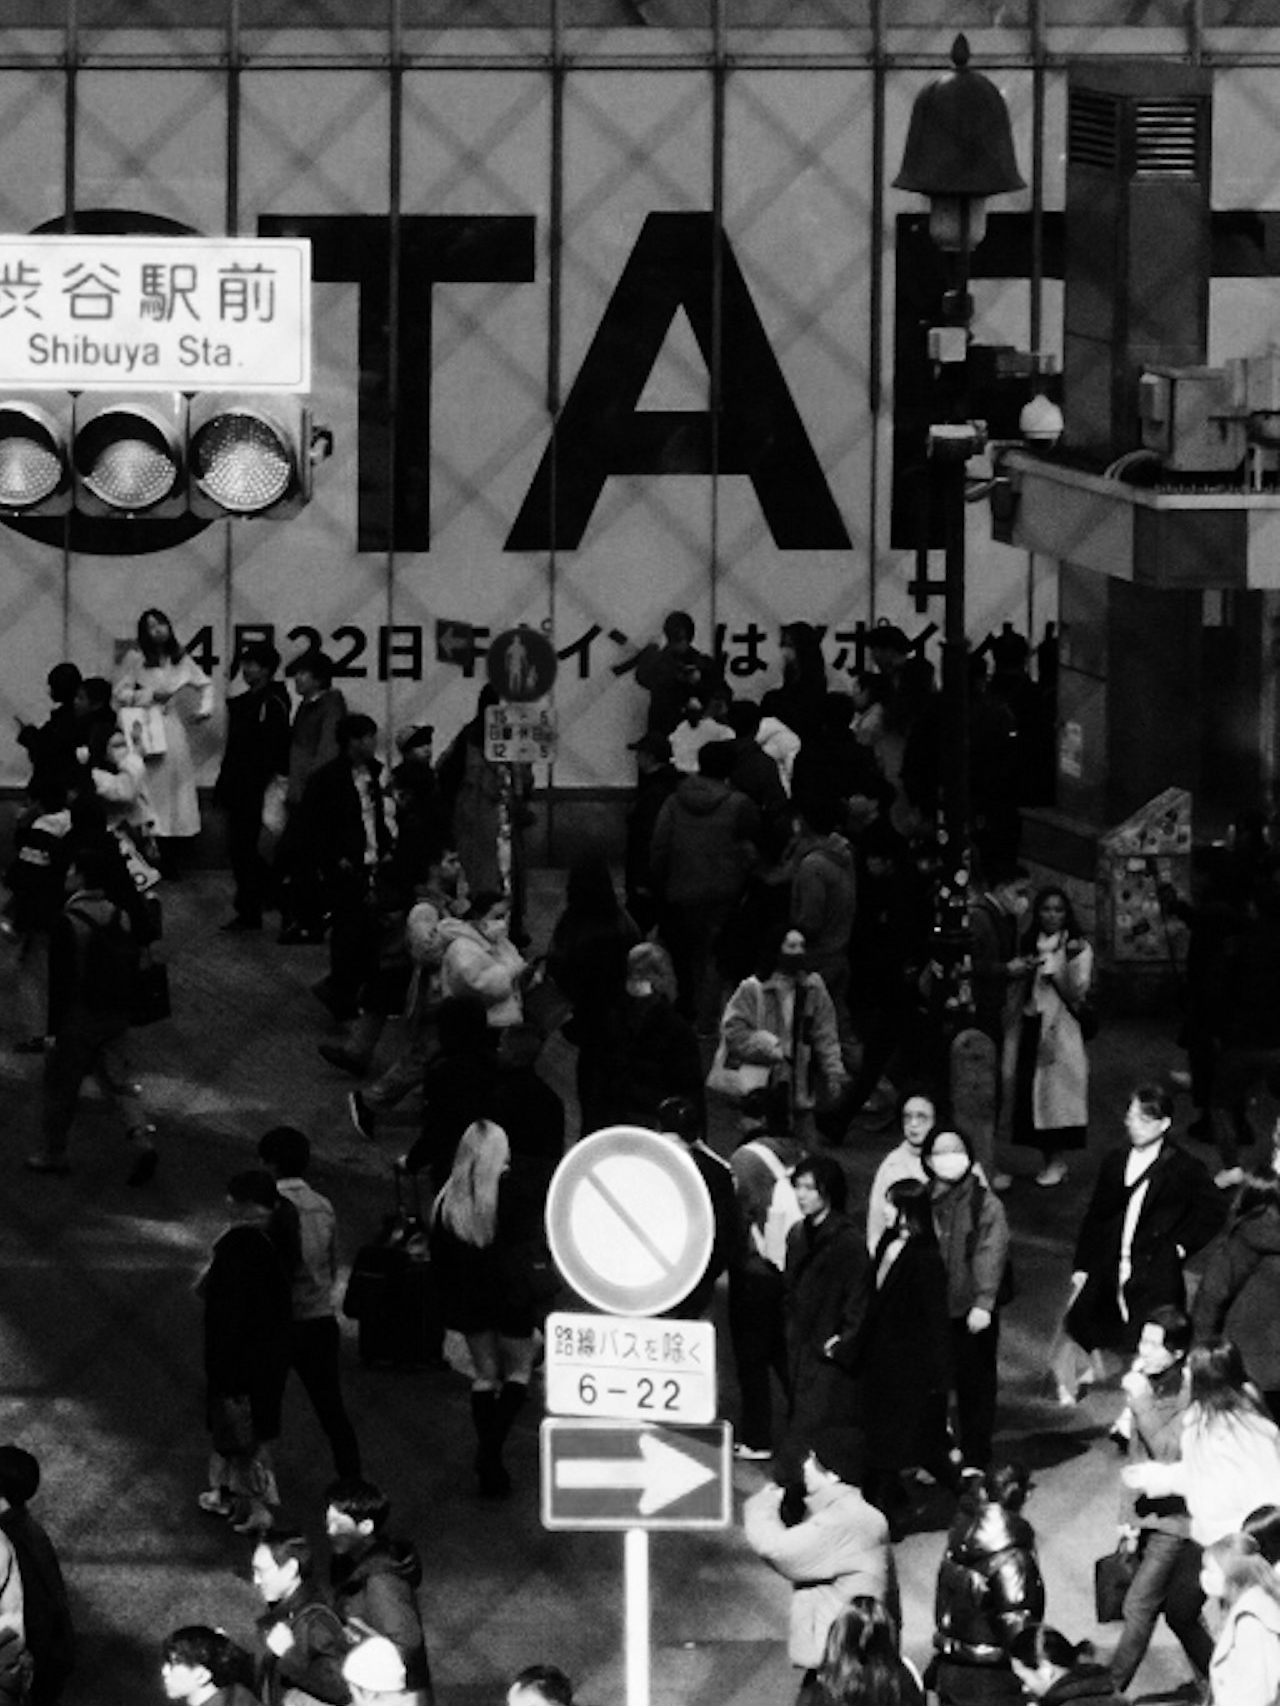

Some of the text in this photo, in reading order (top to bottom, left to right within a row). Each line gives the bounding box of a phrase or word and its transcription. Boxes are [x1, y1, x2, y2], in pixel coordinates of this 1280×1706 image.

[28, 332, 245, 372] Shibuya Sta.
[553, 1323, 703, 1365] 路線バスを除く
[578, 1371, 682, 1412] 6-22
